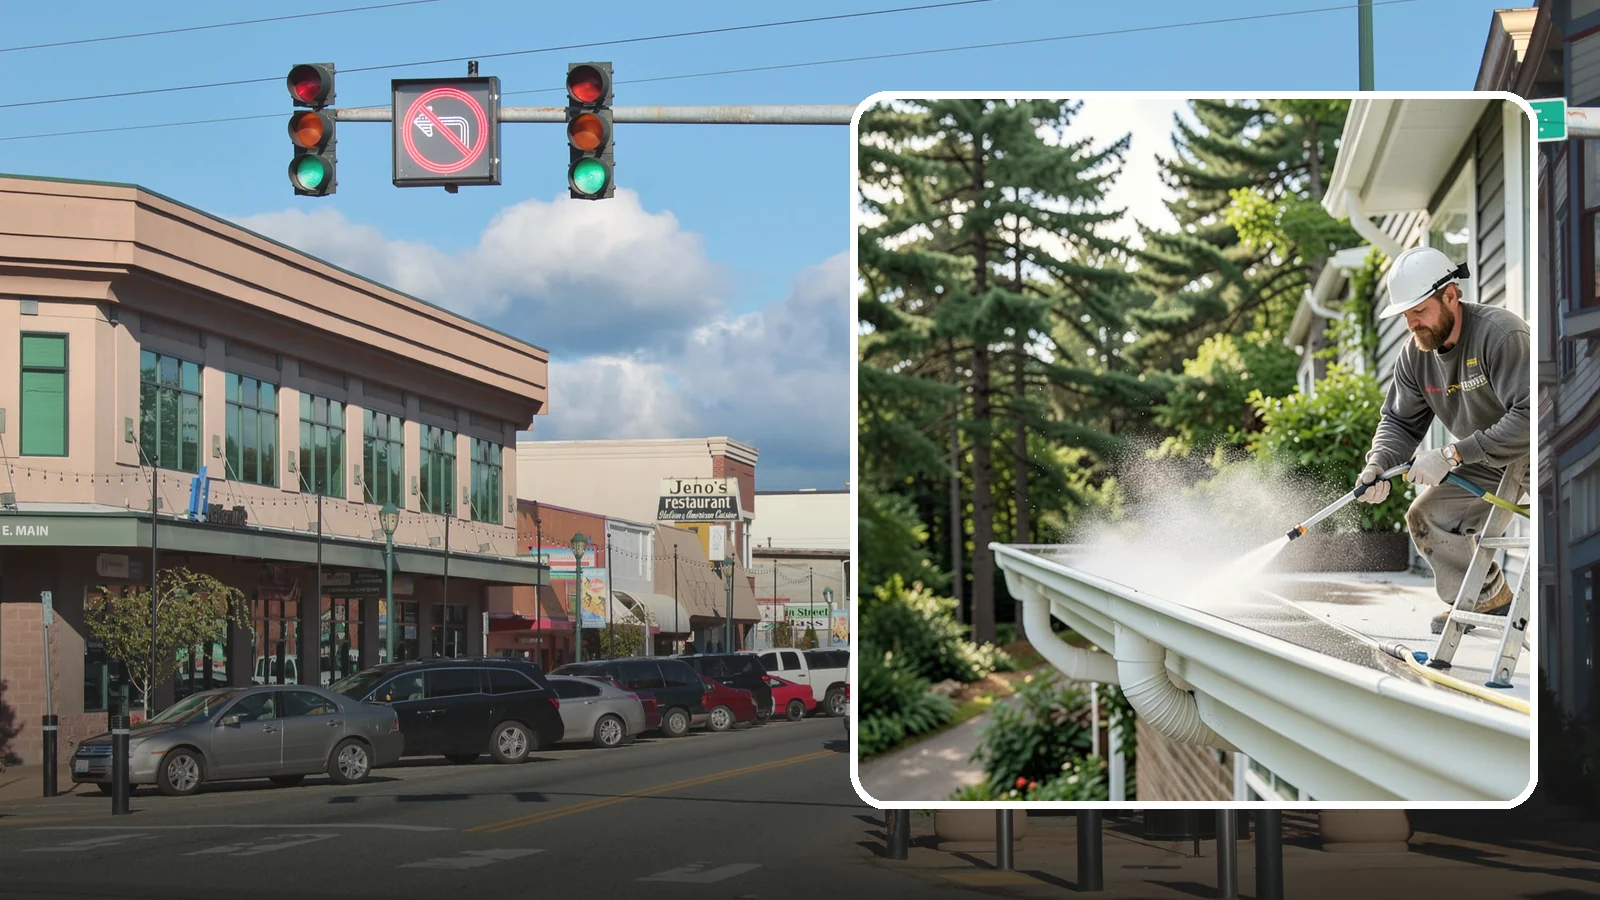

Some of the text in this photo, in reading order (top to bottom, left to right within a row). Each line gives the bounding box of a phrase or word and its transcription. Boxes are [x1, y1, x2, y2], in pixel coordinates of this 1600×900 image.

[669, 480, 728, 494] Jeno's
[665, 496, 731, 509] restaurant
[658, 510, 682, 519] Italian
[686, 510, 714, 519] American
[715, 509, 737, 519] Cuisine
[2, 525, 49, 536] E. MAIN
[797, 607, 829, 617] Street
